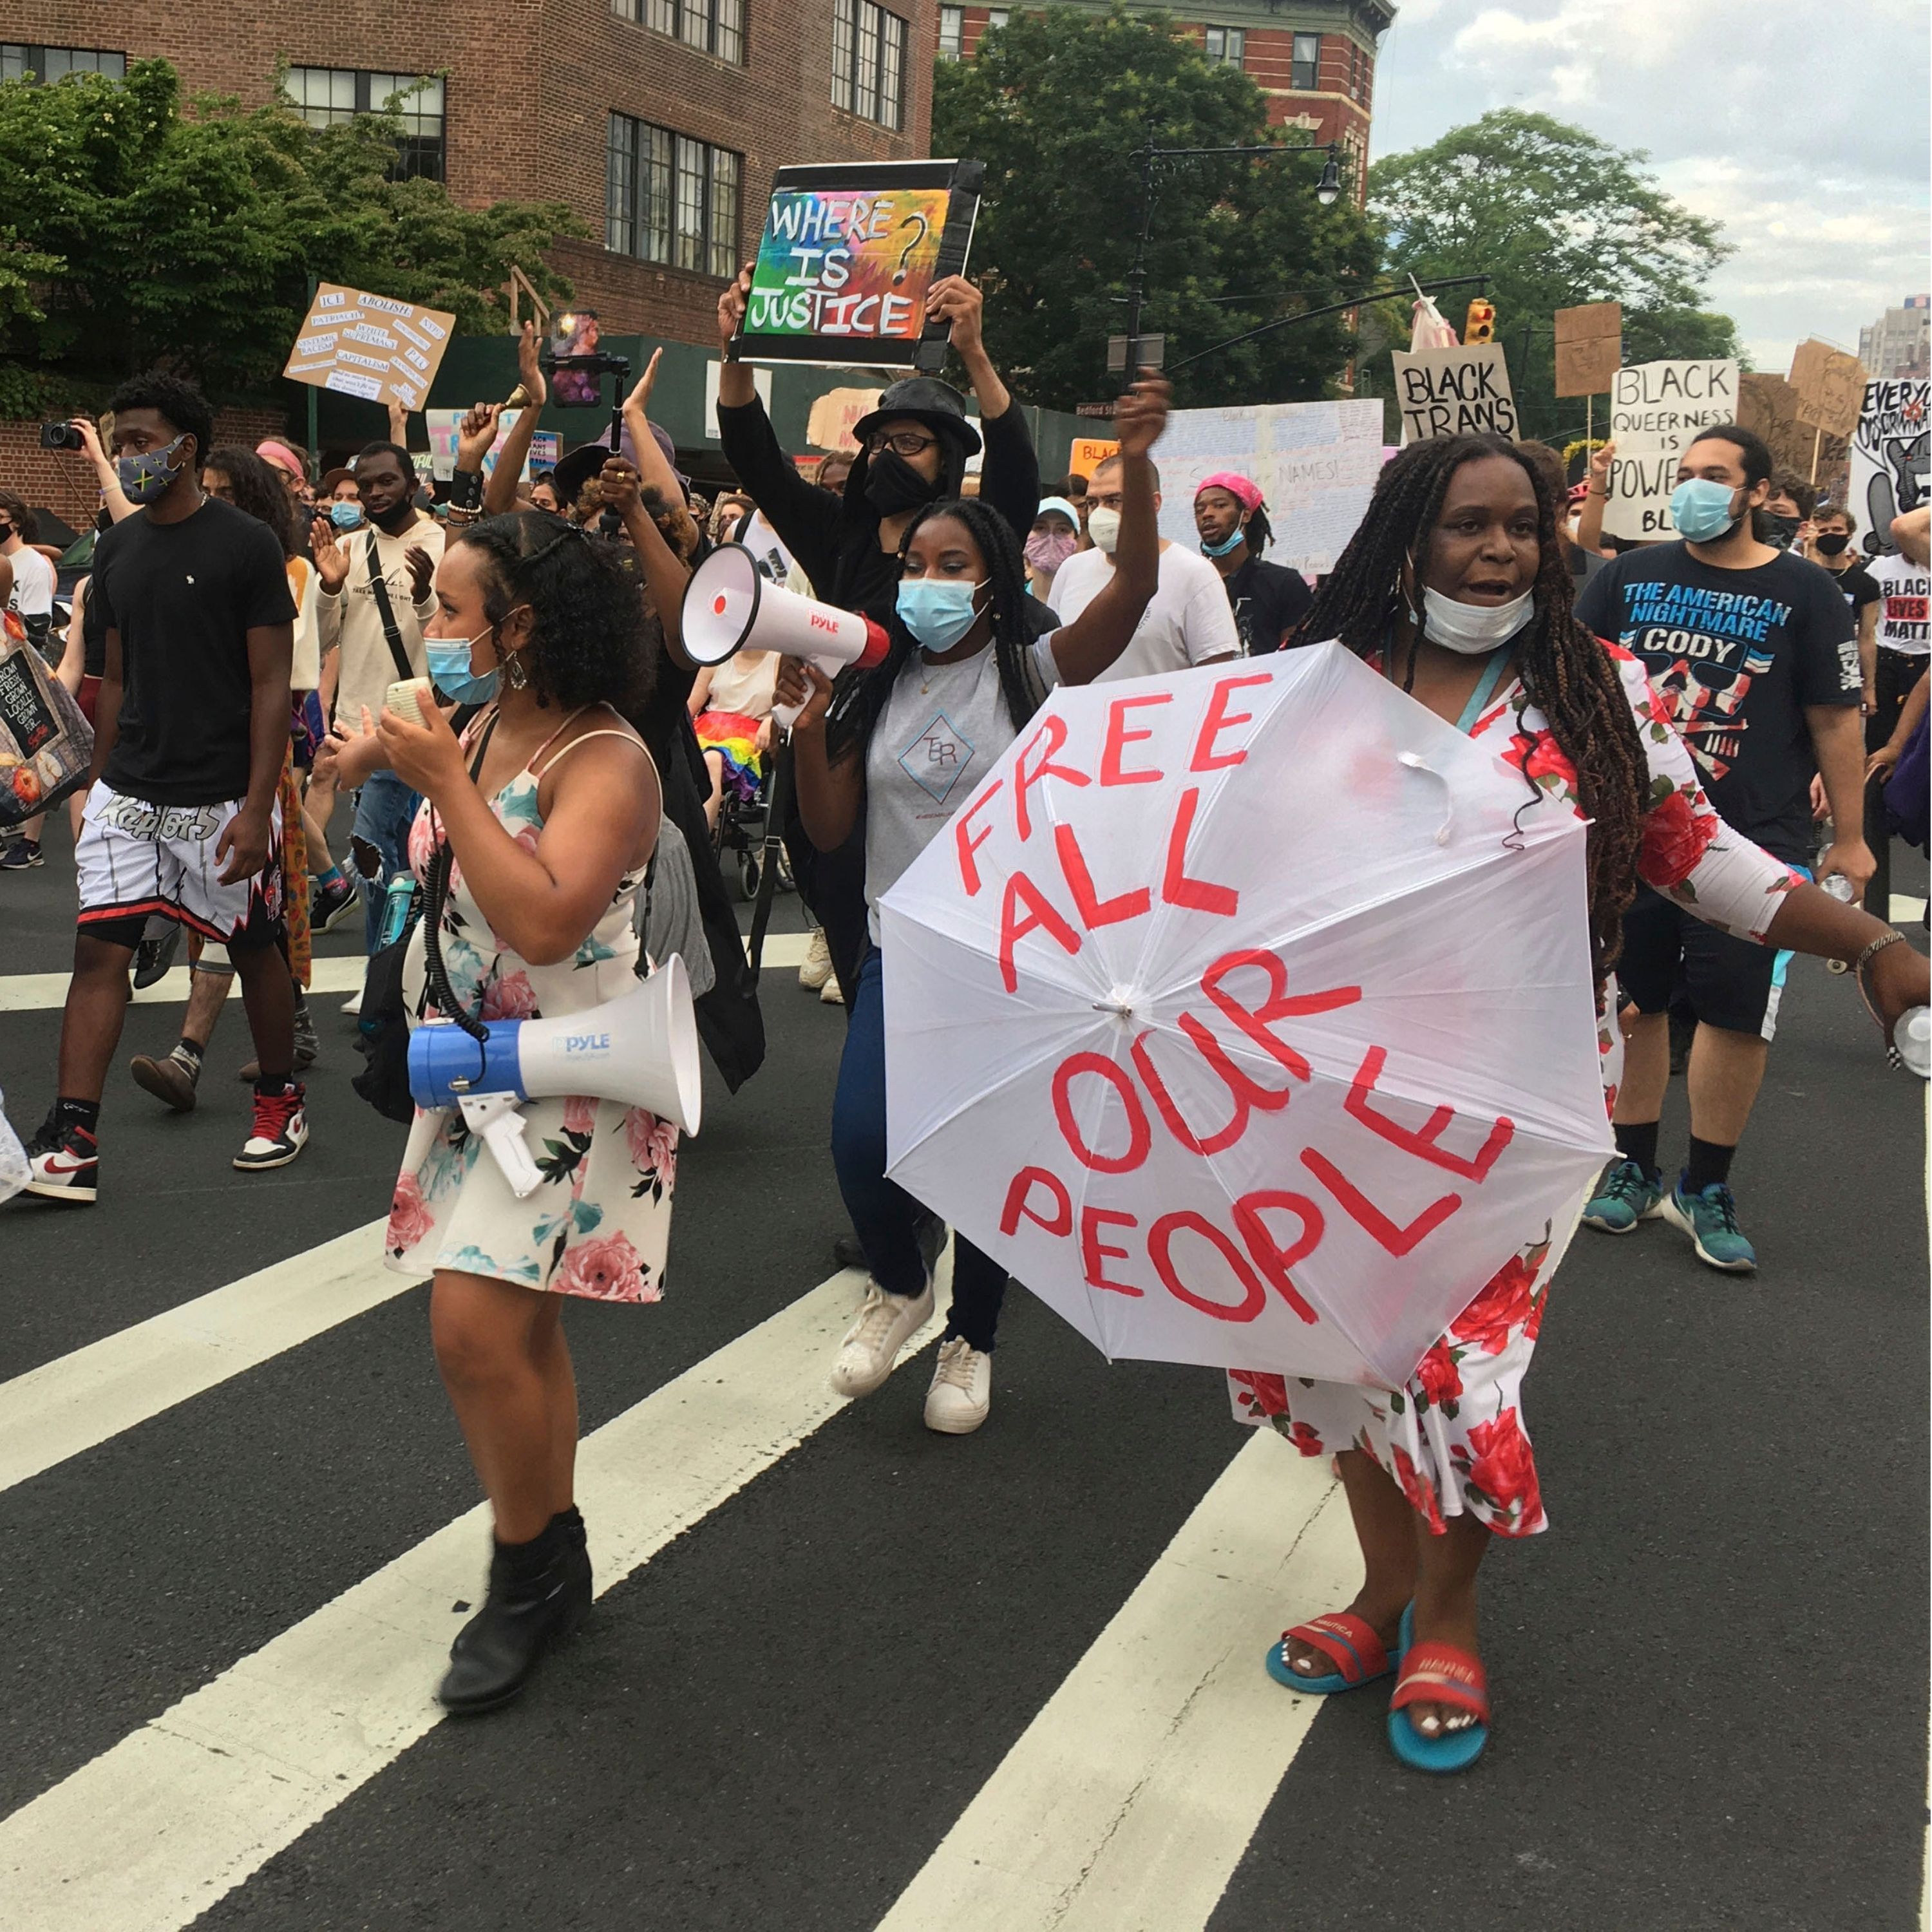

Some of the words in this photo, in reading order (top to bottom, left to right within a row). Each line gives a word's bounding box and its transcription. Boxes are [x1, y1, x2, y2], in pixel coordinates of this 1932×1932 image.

[772, 198, 895, 246] WHERE
[784, 247, 850, 289] IS
[323, 294, 343, 306] ICE
[751, 287, 913, 334] JUSTICE
[302, 342, 333, 354] RACISM
[337, 350, 388, 370] CAPITALISM
[1402, 362, 1499, 404] BLACK
[1617, 364, 1730, 405] BLACK
[1404, 397, 1514, 438] TRANS
[1613, 408, 1734, 432] QUEERNESS
[1661, 435, 1680, 450] IS
[1642, 509, 1675, 532] BL
[1624, 582, 1665, 603] THE
[1665, 584, 1792, 627] AMERICAN
[1630, 602, 1770, 642] NIGHTMARE
[1887, 600, 1926, 618] LIVES
[1643, 628, 1737, 664] CODY
[1884, 621, 1931, 639] MATT
[0, 661, 17, 682] ROWN
[5, 681, 27, 705] GROWN
[17, 701, 38, 724] GROWN
[956, 674, 1272, 896] FREE
[999, 788, 1238, 993] ALL
[1052, 949, 1361, 1174] OUR
[1001, 1046, 1514, 1324] PEOPLE
